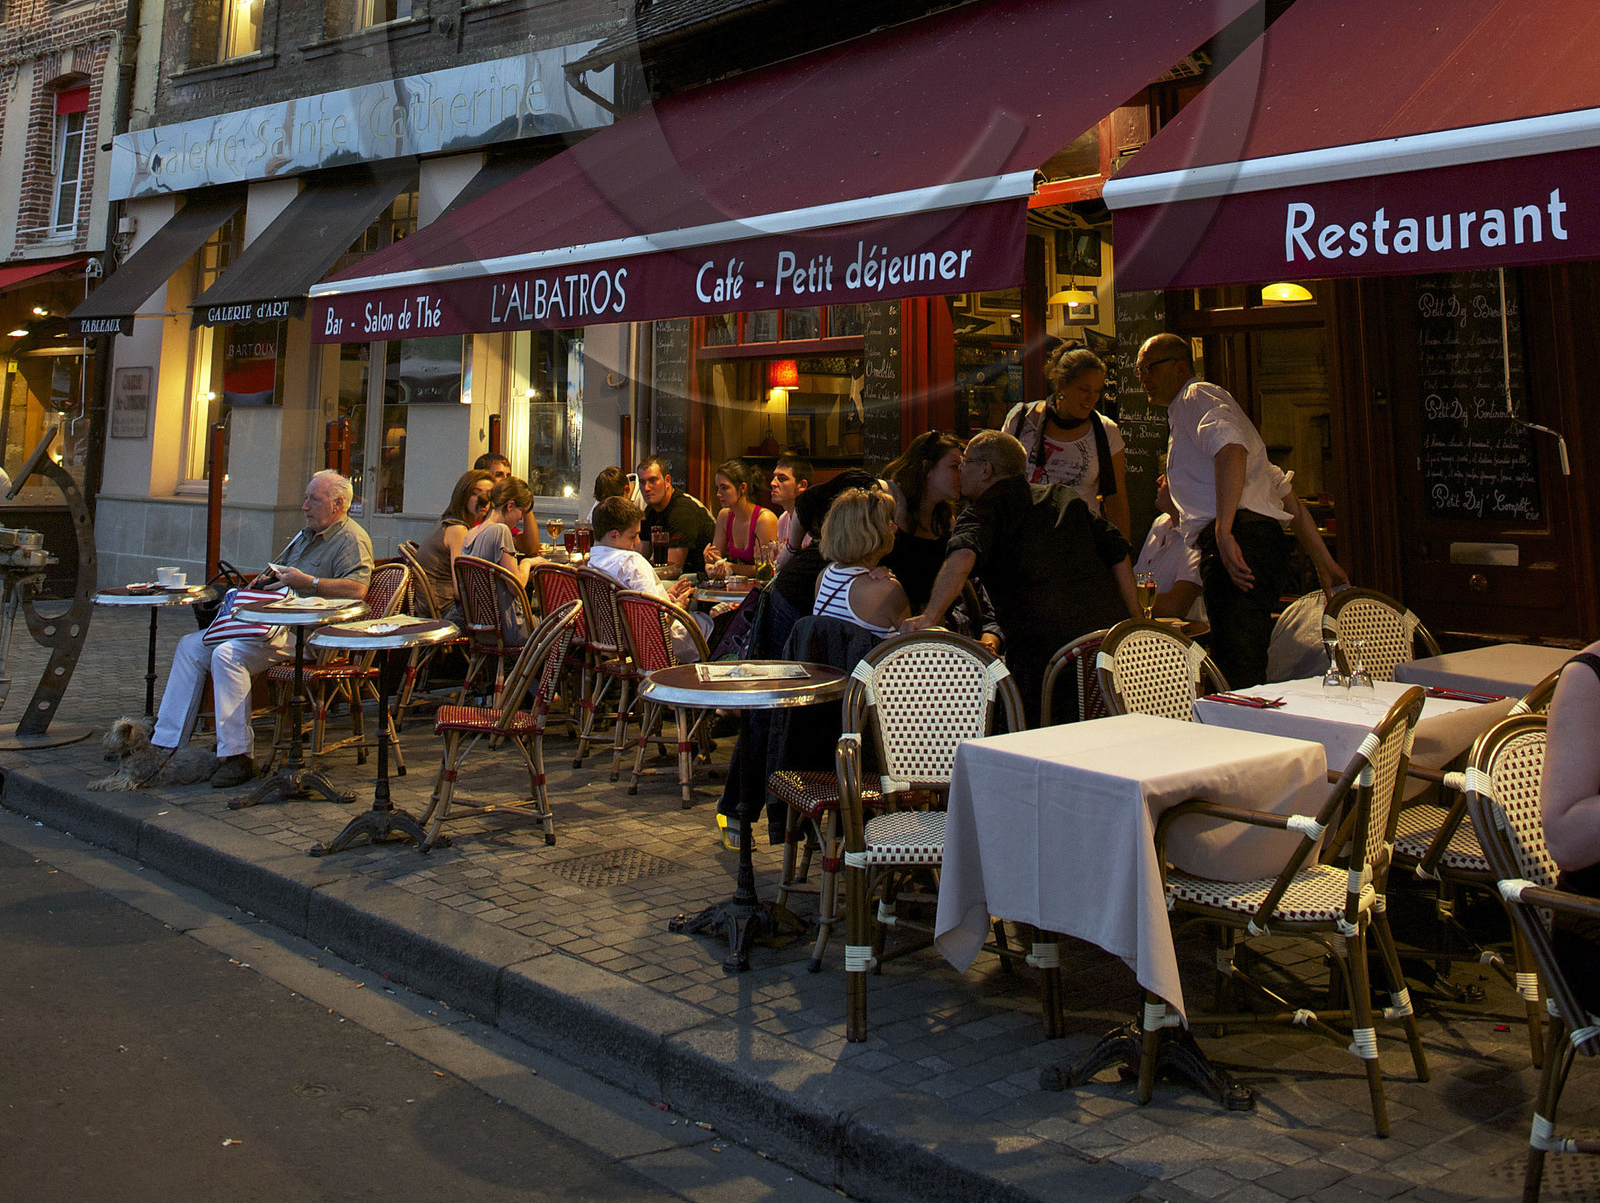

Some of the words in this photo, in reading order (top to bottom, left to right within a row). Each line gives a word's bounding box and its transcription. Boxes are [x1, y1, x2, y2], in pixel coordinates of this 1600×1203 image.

[148, 133, 241, 178] Galerie
[258, 108, 347, 161] Sainte
[372, 73, 546, 141] Catherine
[1284, 187, 1569, 263] Restaurant
[695, 258, 744, 303] Café
[775, 250, 833, 295] Petit
[845, 240, 972, 292] déjeuner
[207, 305, 251, 322] GALERIE
[256, 301, 290, 318] d'ART
[324, 306, 344, 336] Bar
[364, 302, 393, 333] Salon
[397, 299, 411, 329] de
[416, 296, 442, 328] Thé
[490, 268, 628, 324] L'ALBATROS
[80, 318, 121, 333] TABLEAUX
[228, 342, 275, 358] BARTOUX
